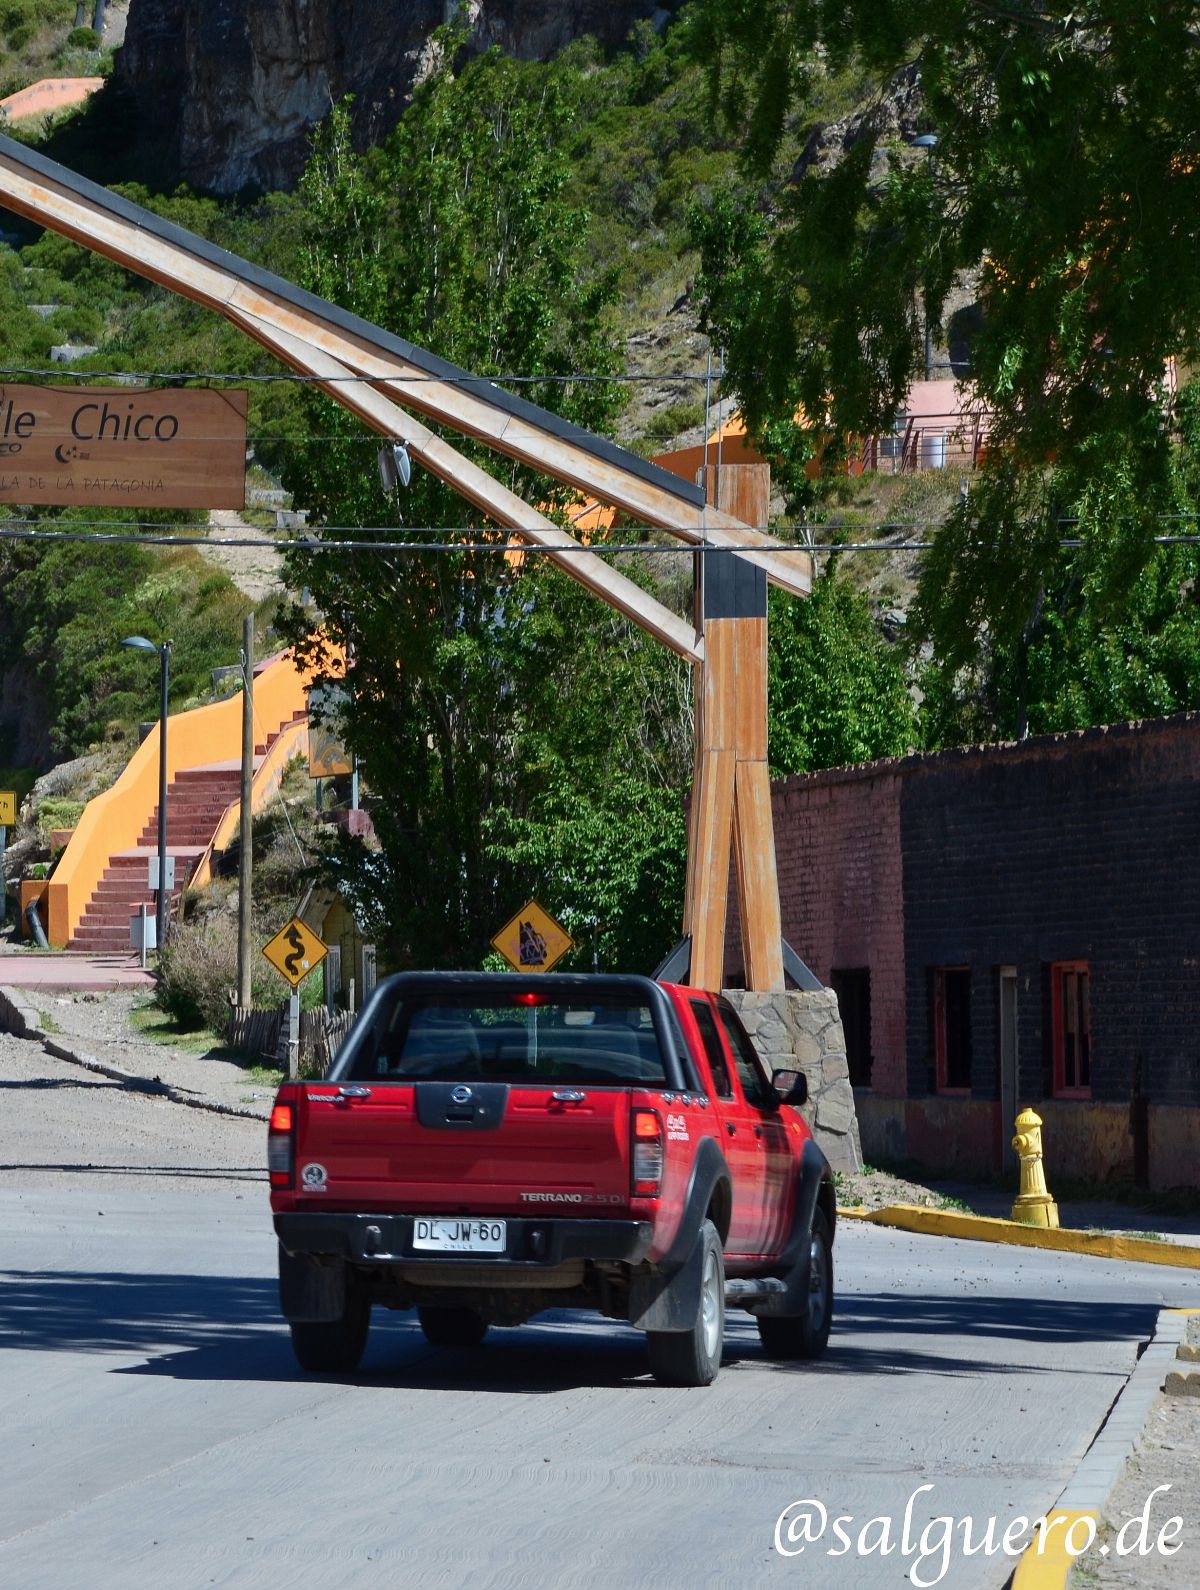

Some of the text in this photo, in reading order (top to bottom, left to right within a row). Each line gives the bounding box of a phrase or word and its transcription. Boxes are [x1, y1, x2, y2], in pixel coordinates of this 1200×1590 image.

[71, 402, 179, 442] Chico
[29, 477, 45, 489] DE
[56, 478, 74, 489] LA
[84, 478, 164, 492] PATAGONIA
[520, 1192, 582, 1203] TERRANO
